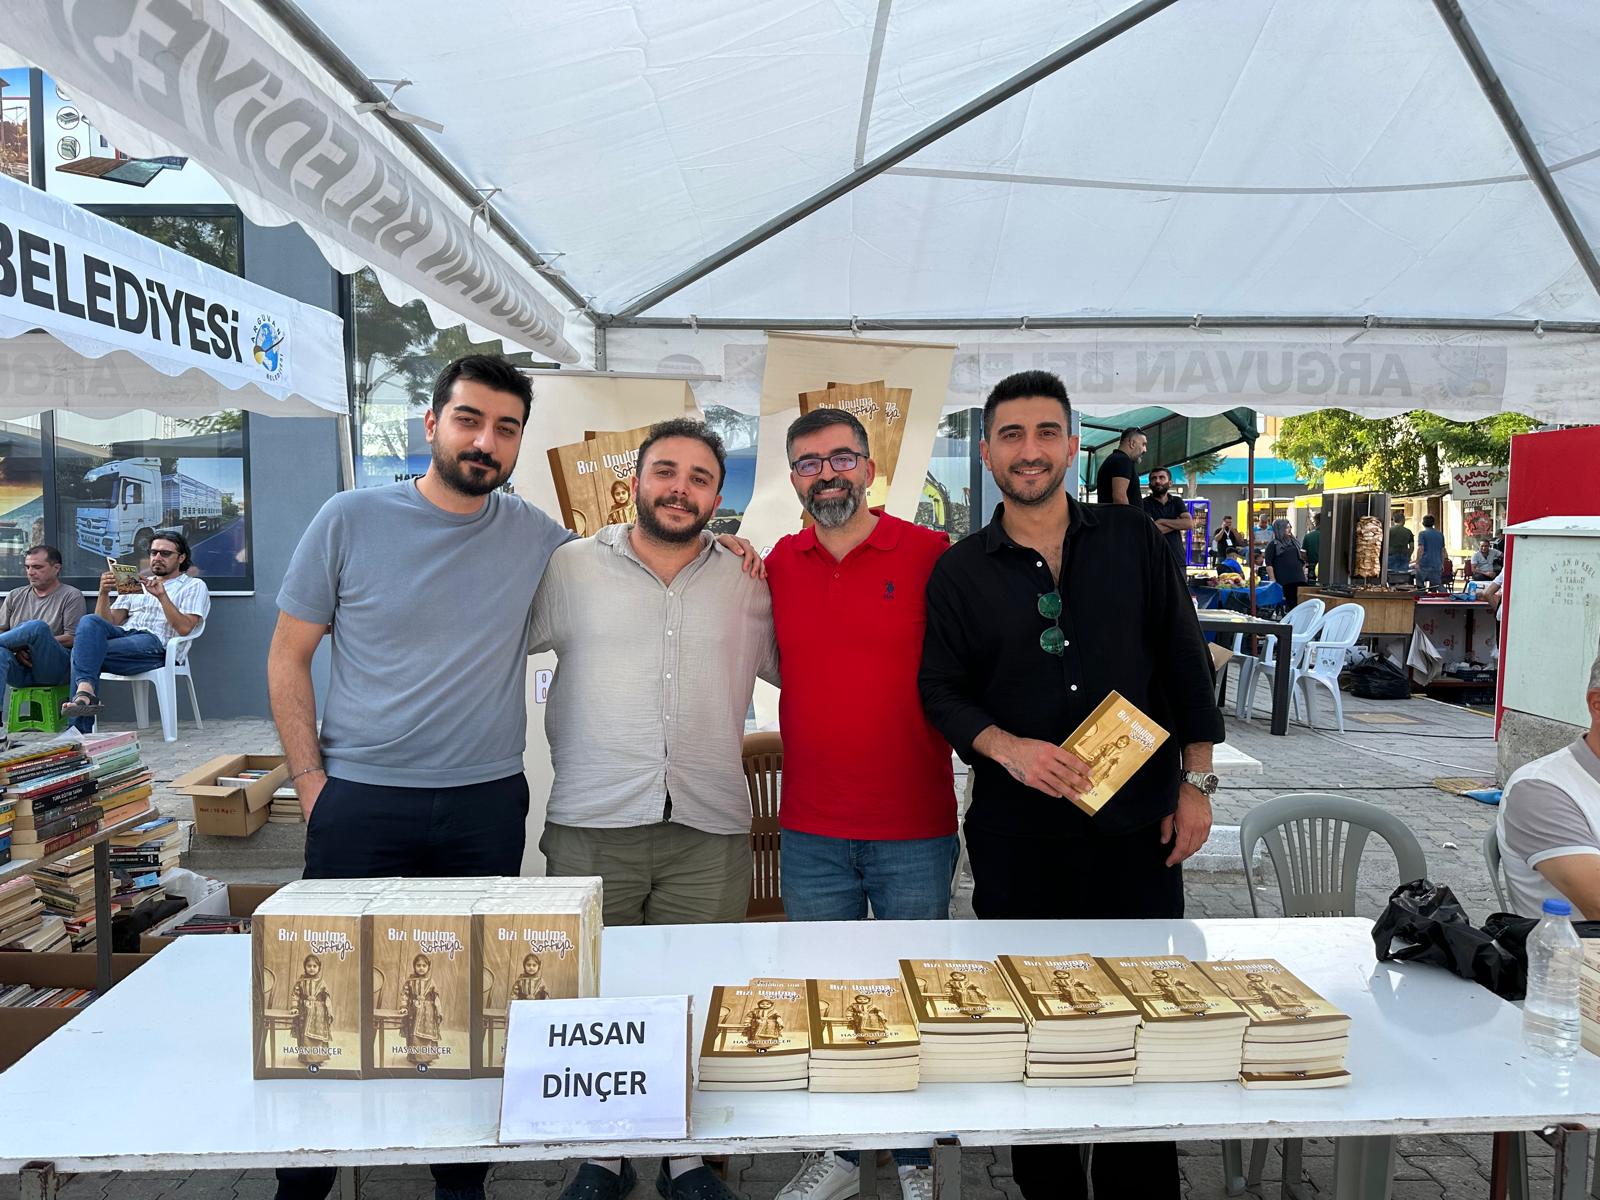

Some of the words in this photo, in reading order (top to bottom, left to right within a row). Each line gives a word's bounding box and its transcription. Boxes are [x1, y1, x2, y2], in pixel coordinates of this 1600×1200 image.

[602, 448, 640, 468] Unutm
[303, 929, 347, 942] Unutma
[413, 928, 456, 942] Unutma
[523, 928, 567, 941] Unutma
[548, 1021, 645, 1047] HASAN
[283, 1046, 310, 1055] HASAN
[392, 1046, 419, 1054] HASAN
[543, 1067, 647, 1103] DİNÇER
